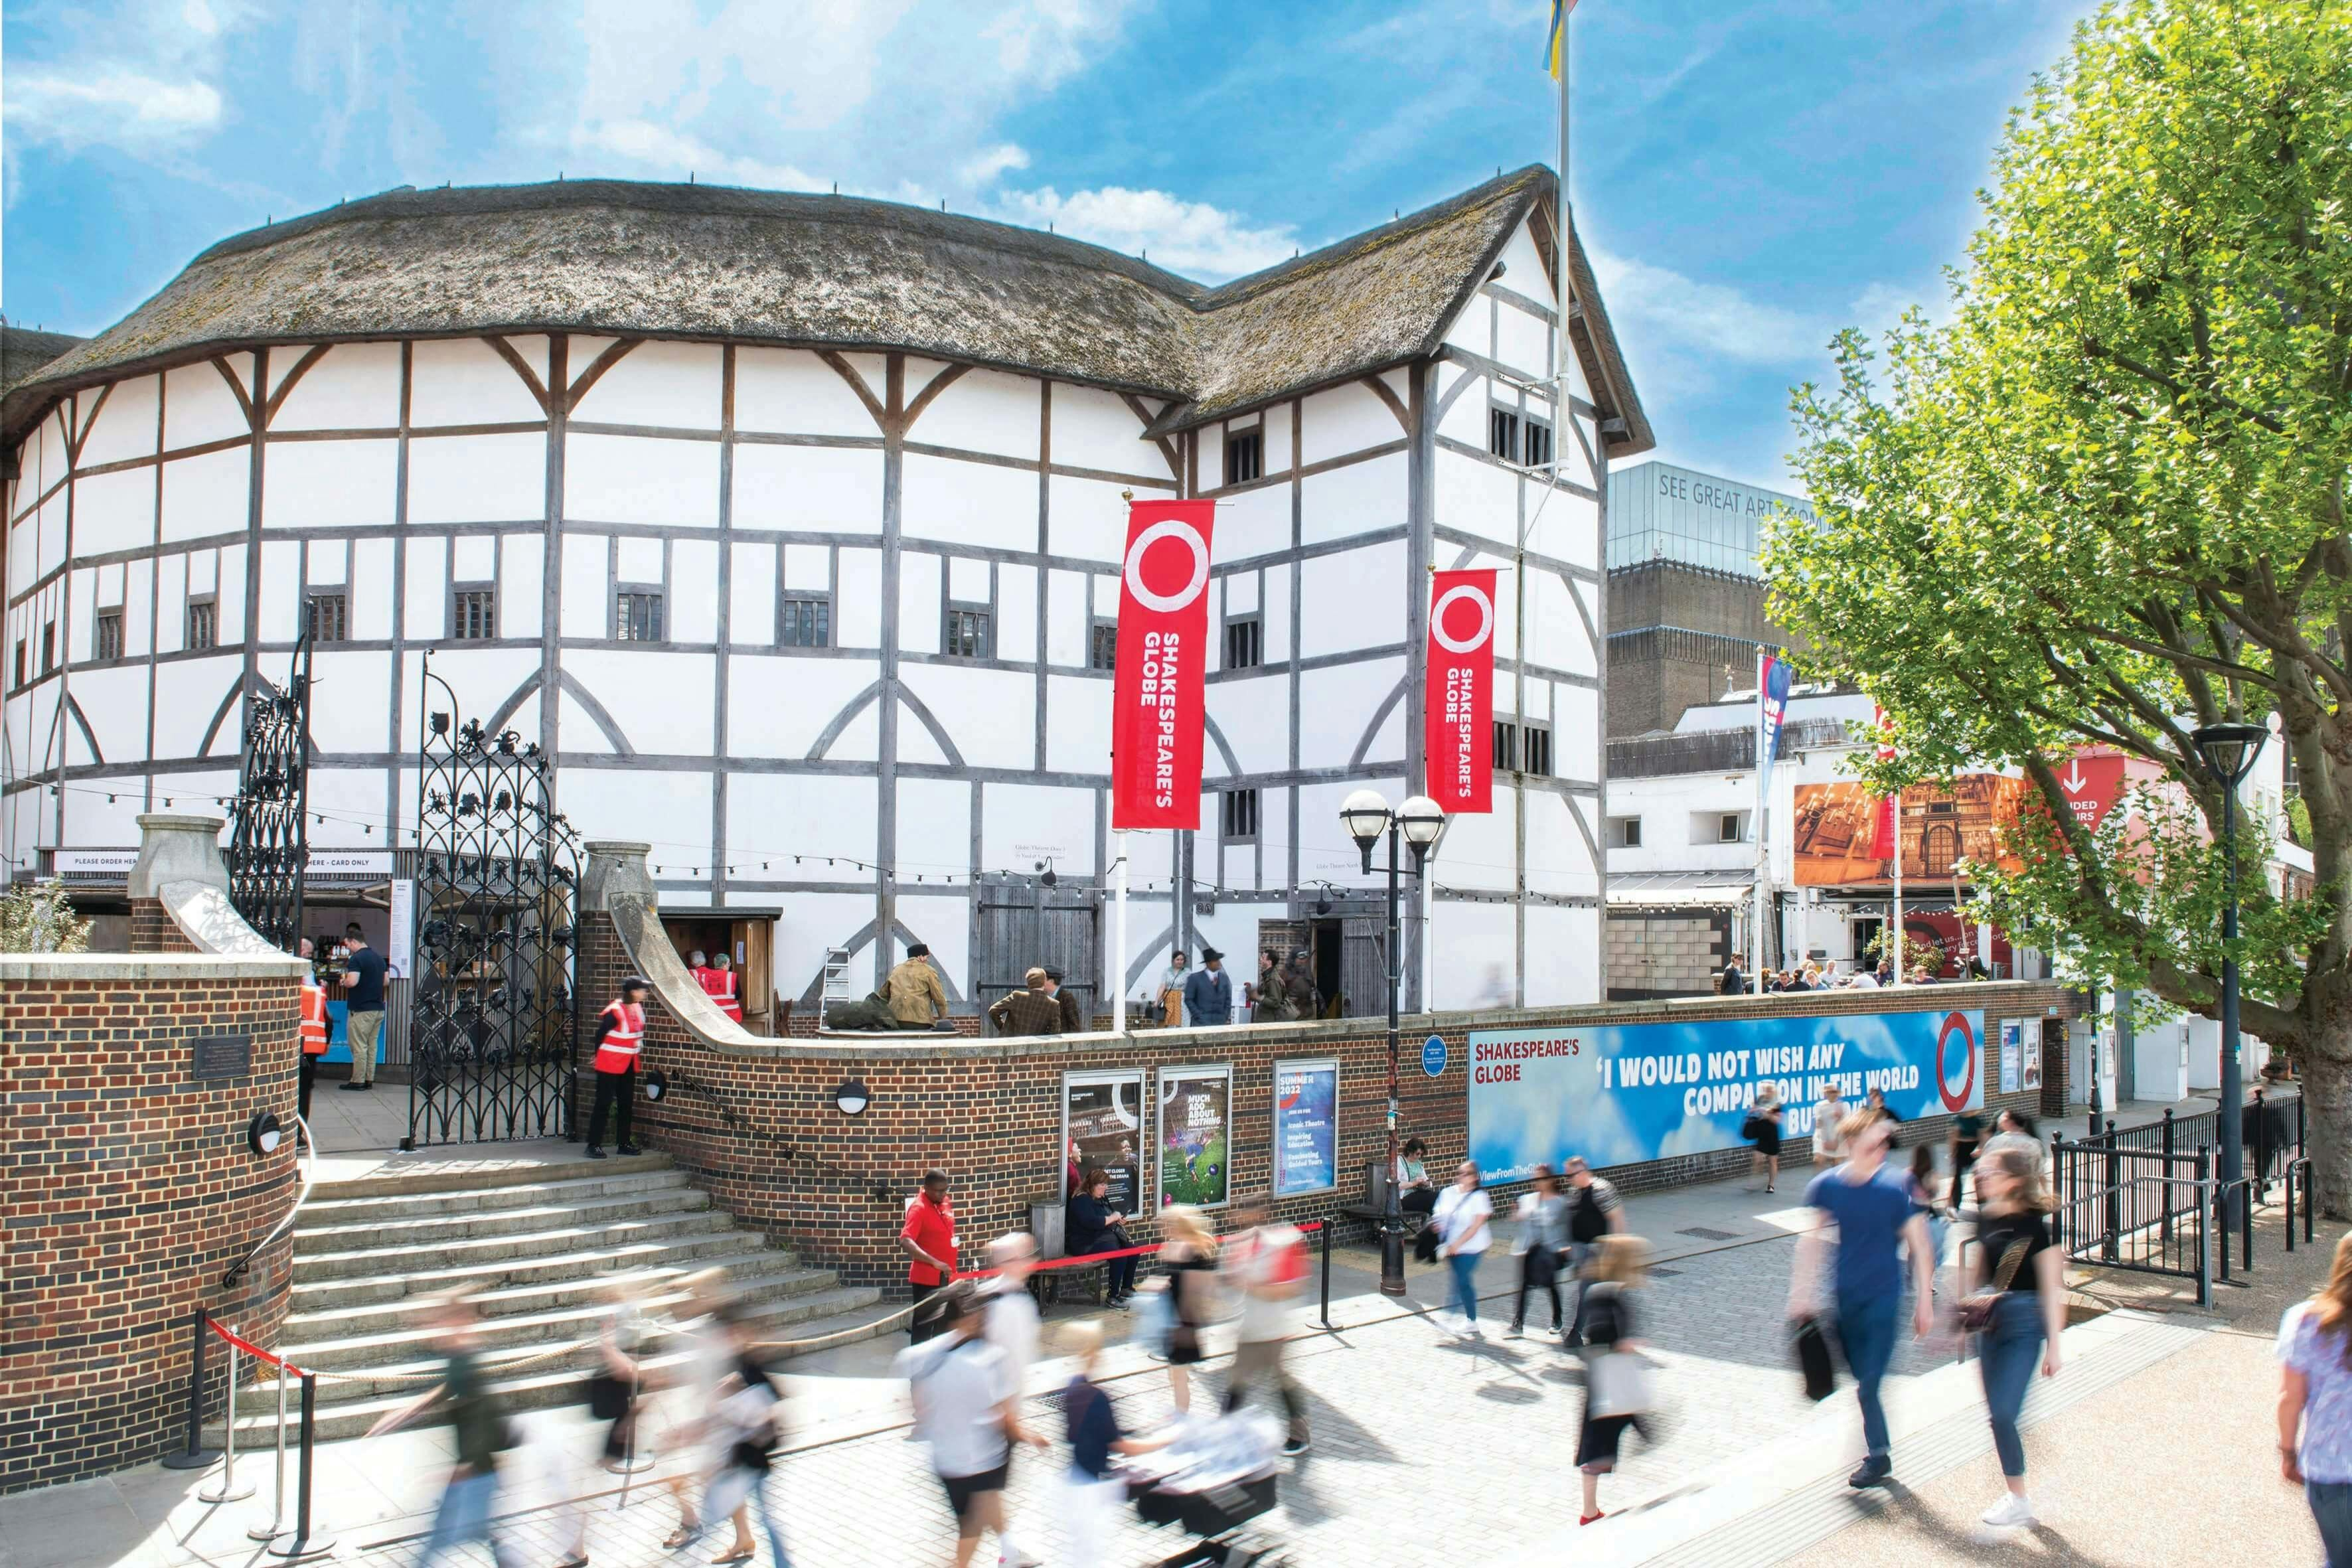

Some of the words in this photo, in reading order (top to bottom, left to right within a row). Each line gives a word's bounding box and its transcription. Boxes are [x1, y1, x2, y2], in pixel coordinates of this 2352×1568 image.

[1660, 474, 1687, 501] SEE
[1693, 483, 1741, 513] GREAT
[1745, 496, 1774, 518] ART
[1140, 631, 1160, 707] GLOBE
[1445, 667, 1459, 724] GLOBE
[1156, 632, 1180, 808] SHAKESPEARE'S
[1458, 667, 1473, 798] SHAKESPEARE'S
[1932, 937, 1944, 946] let
[1475, 1038, 1579, 1062] SHAKESPEARE'S
[1618, 1052, 1701, 1088] WOULD
[1708, 1050, 1751, 1081] NOT
[1755, 1046, 1804, 1075] WISH
[1808, 1042, 1845, 1070] ANY
[1475, 1064, 1521, 1084] GLOBE
[1279, 1075, 1314, 1086] SUMMER
[1279, 1085, 1301, 1095] 2022
[1683, 1076, 1802, 1117] COMPAON
[1808, 1073, 1825, 1102] IN
[1865, 1064, 1919, 1093] WORLD
[1188, 1093, 1211, 1104] MUCH
[1188, 1102, 1206, 1111] ADO
[1188, 1109, 1215, 1119] ABOUT
[1188, 1116, 1221, 1127] NOTHING
[1287, 1121, 1304, 1129] Iconic
[1788, 1105, 1817, 1136] BU
[1287, 1133, 1312, 1142] Inspiring
[1287, 1140, 1314, 1148] Education
[1288, 1160, 1307, 1168] Guided
